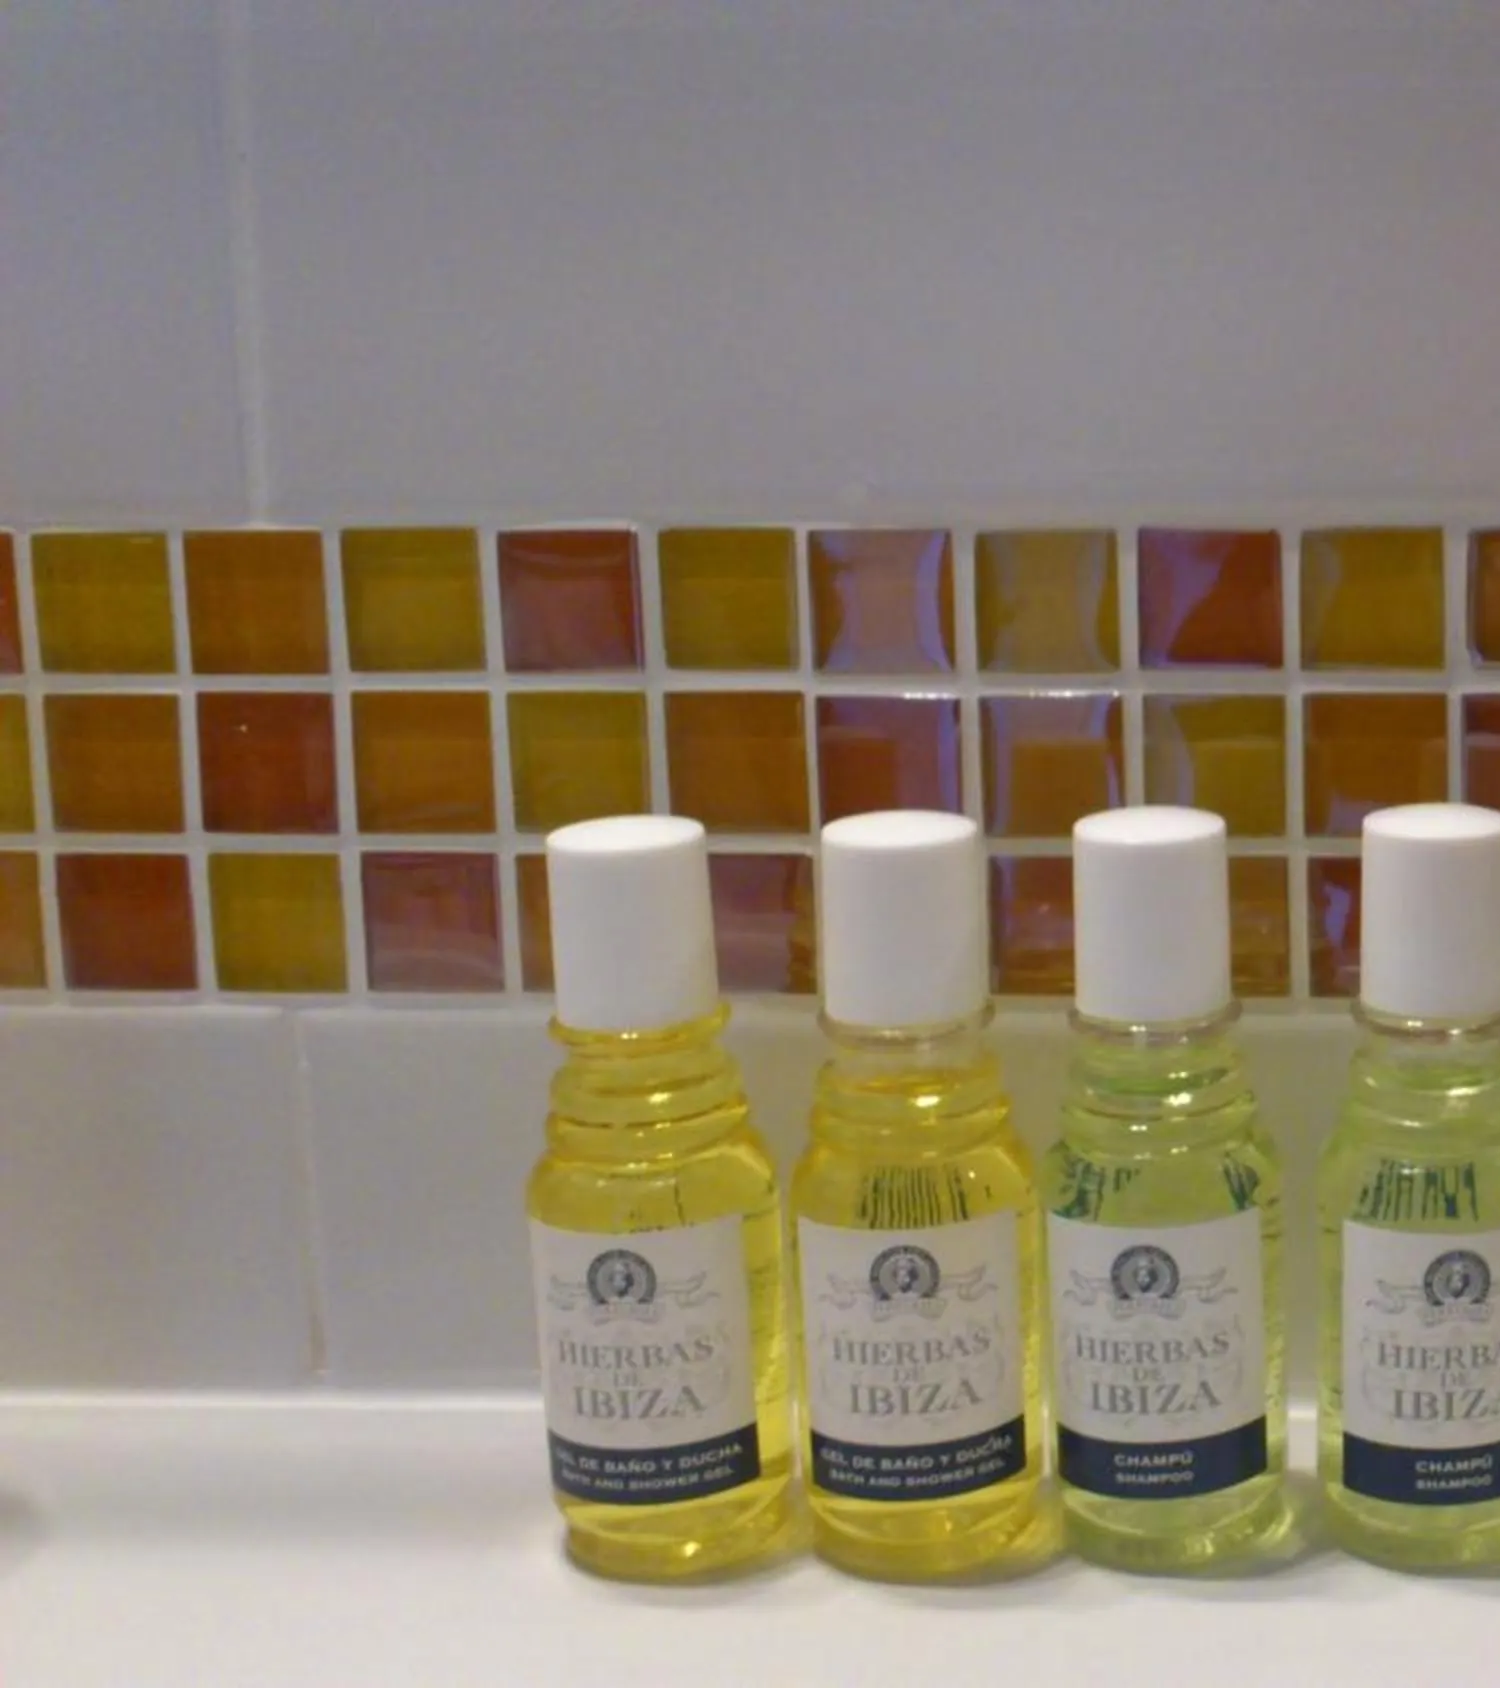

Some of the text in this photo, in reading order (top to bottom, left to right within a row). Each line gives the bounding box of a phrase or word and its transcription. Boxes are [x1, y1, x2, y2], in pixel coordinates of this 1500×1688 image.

[558, 1336, 715, 1370] HIERBAS
[832, 1328, 992, 1365] HIERBAS
[1076, 1331, 1230, 1366] HIERBAS
[573, 1384, 707, 1420] IBIZA
[850, 1378, 984, 1416] IBIZA
[1091, 1380, 1224, 1416] IBIZA
[578, 1456, 599, 1471] DE
[604, 1459, 656, 1474] BAÑO
[661, 1459, 673, 1471] Y
[678, 1443, 743, 1469] DUCHA
[820, 1447, 848, 1466] GEL
[852, 1455, 876, 1470] DE
[880, 1455, 934, 1471] BAÑO
[940, 1455, 951, 1466] Y
[594, 1478, 624, 1490] AND
[628, 1473, 700, 1491] SHOWER
[703, 1465, 736, 1481] GEL
[869, 1474, 901, 1487] AND
[905, 1467, 975, 1487] SHOWER
[1115, 1470, 1194, 1484] SHAMPOO
[1415, 1474, 1493, 1490] SHAMPOO
